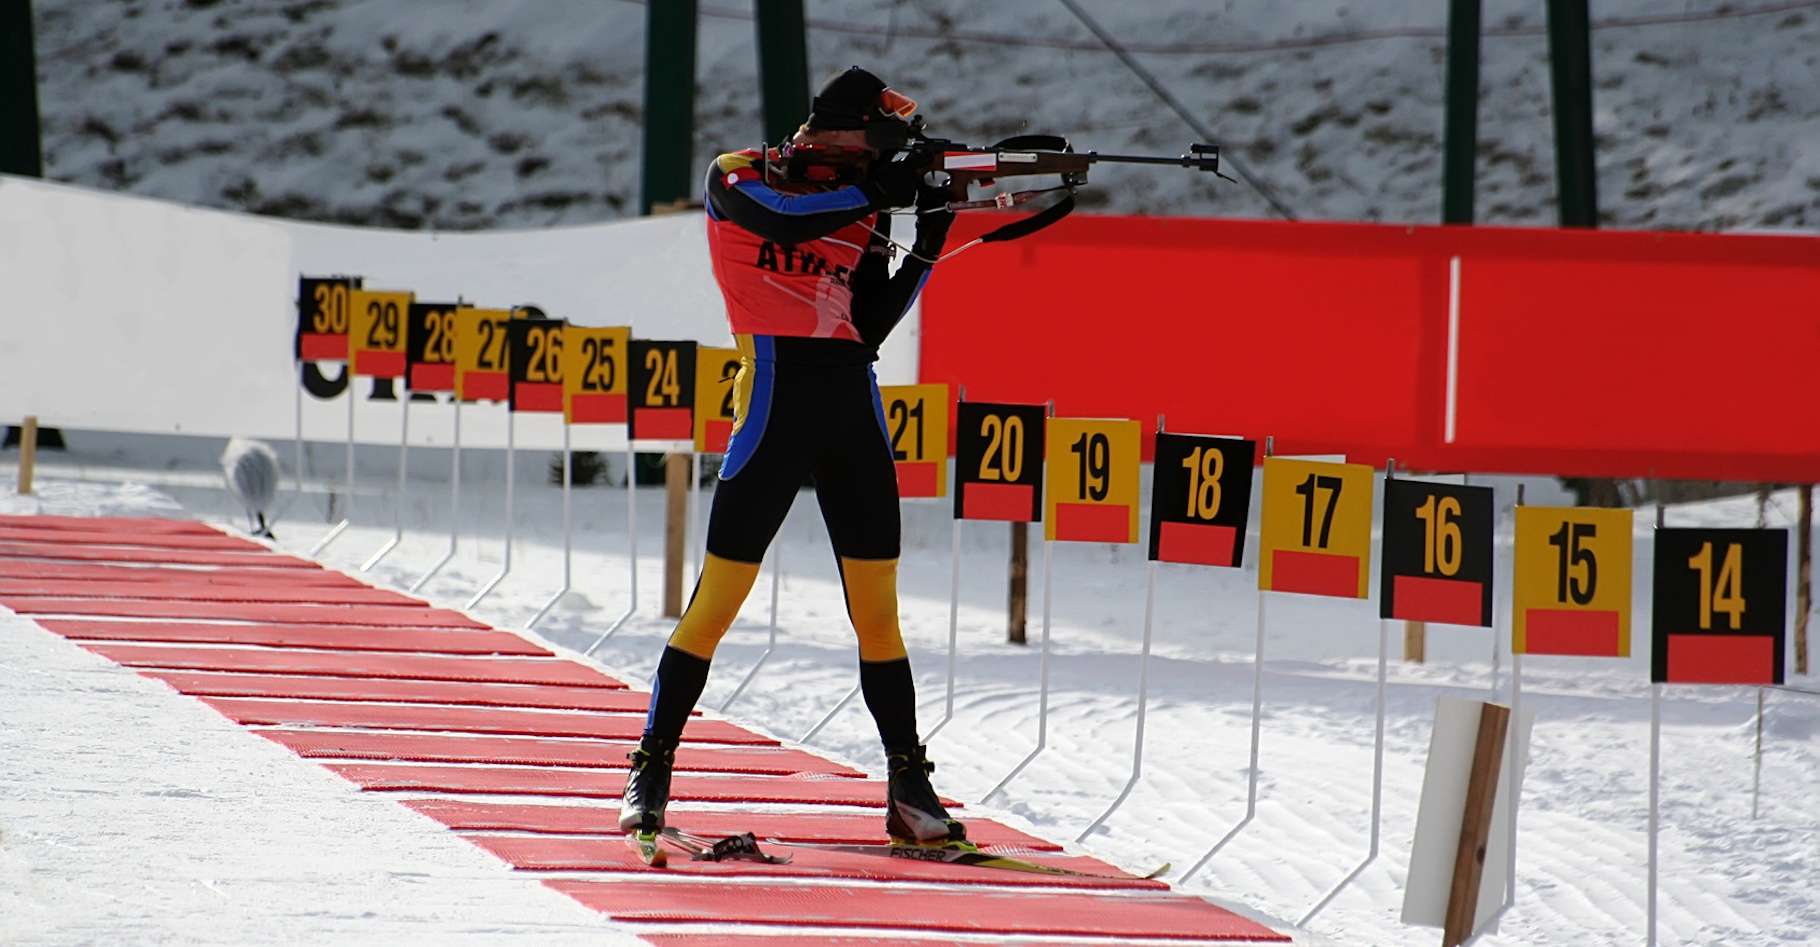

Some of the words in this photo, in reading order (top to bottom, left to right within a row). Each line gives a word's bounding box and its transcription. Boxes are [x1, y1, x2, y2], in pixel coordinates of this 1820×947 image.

[313, 284, 347, 333] 30
[366, 301, 398, 348] 29
[423, 312, 456, 362] 28
[477, 319, 509, 369] 27
[526, 327, 563, 382] 26
[581, 338, 615, 392] 25
[645, 349, 680, 405] 24
[720, 360, 741, 417] 2
[889, 398, 924, 461] 21
[979, 414, 1024, 482] 20
[1071, 432, 1110, 501] 19
[1182, 446, 1224, 520] 18
[1296, 473, 1343, 549] 17
[1415, 495, 1462, 576] 16
[1549, 521, 1597, 606] 15
[1688, 541, 1745, 629] 14
[889, 846, 946, 862] FISCHER
